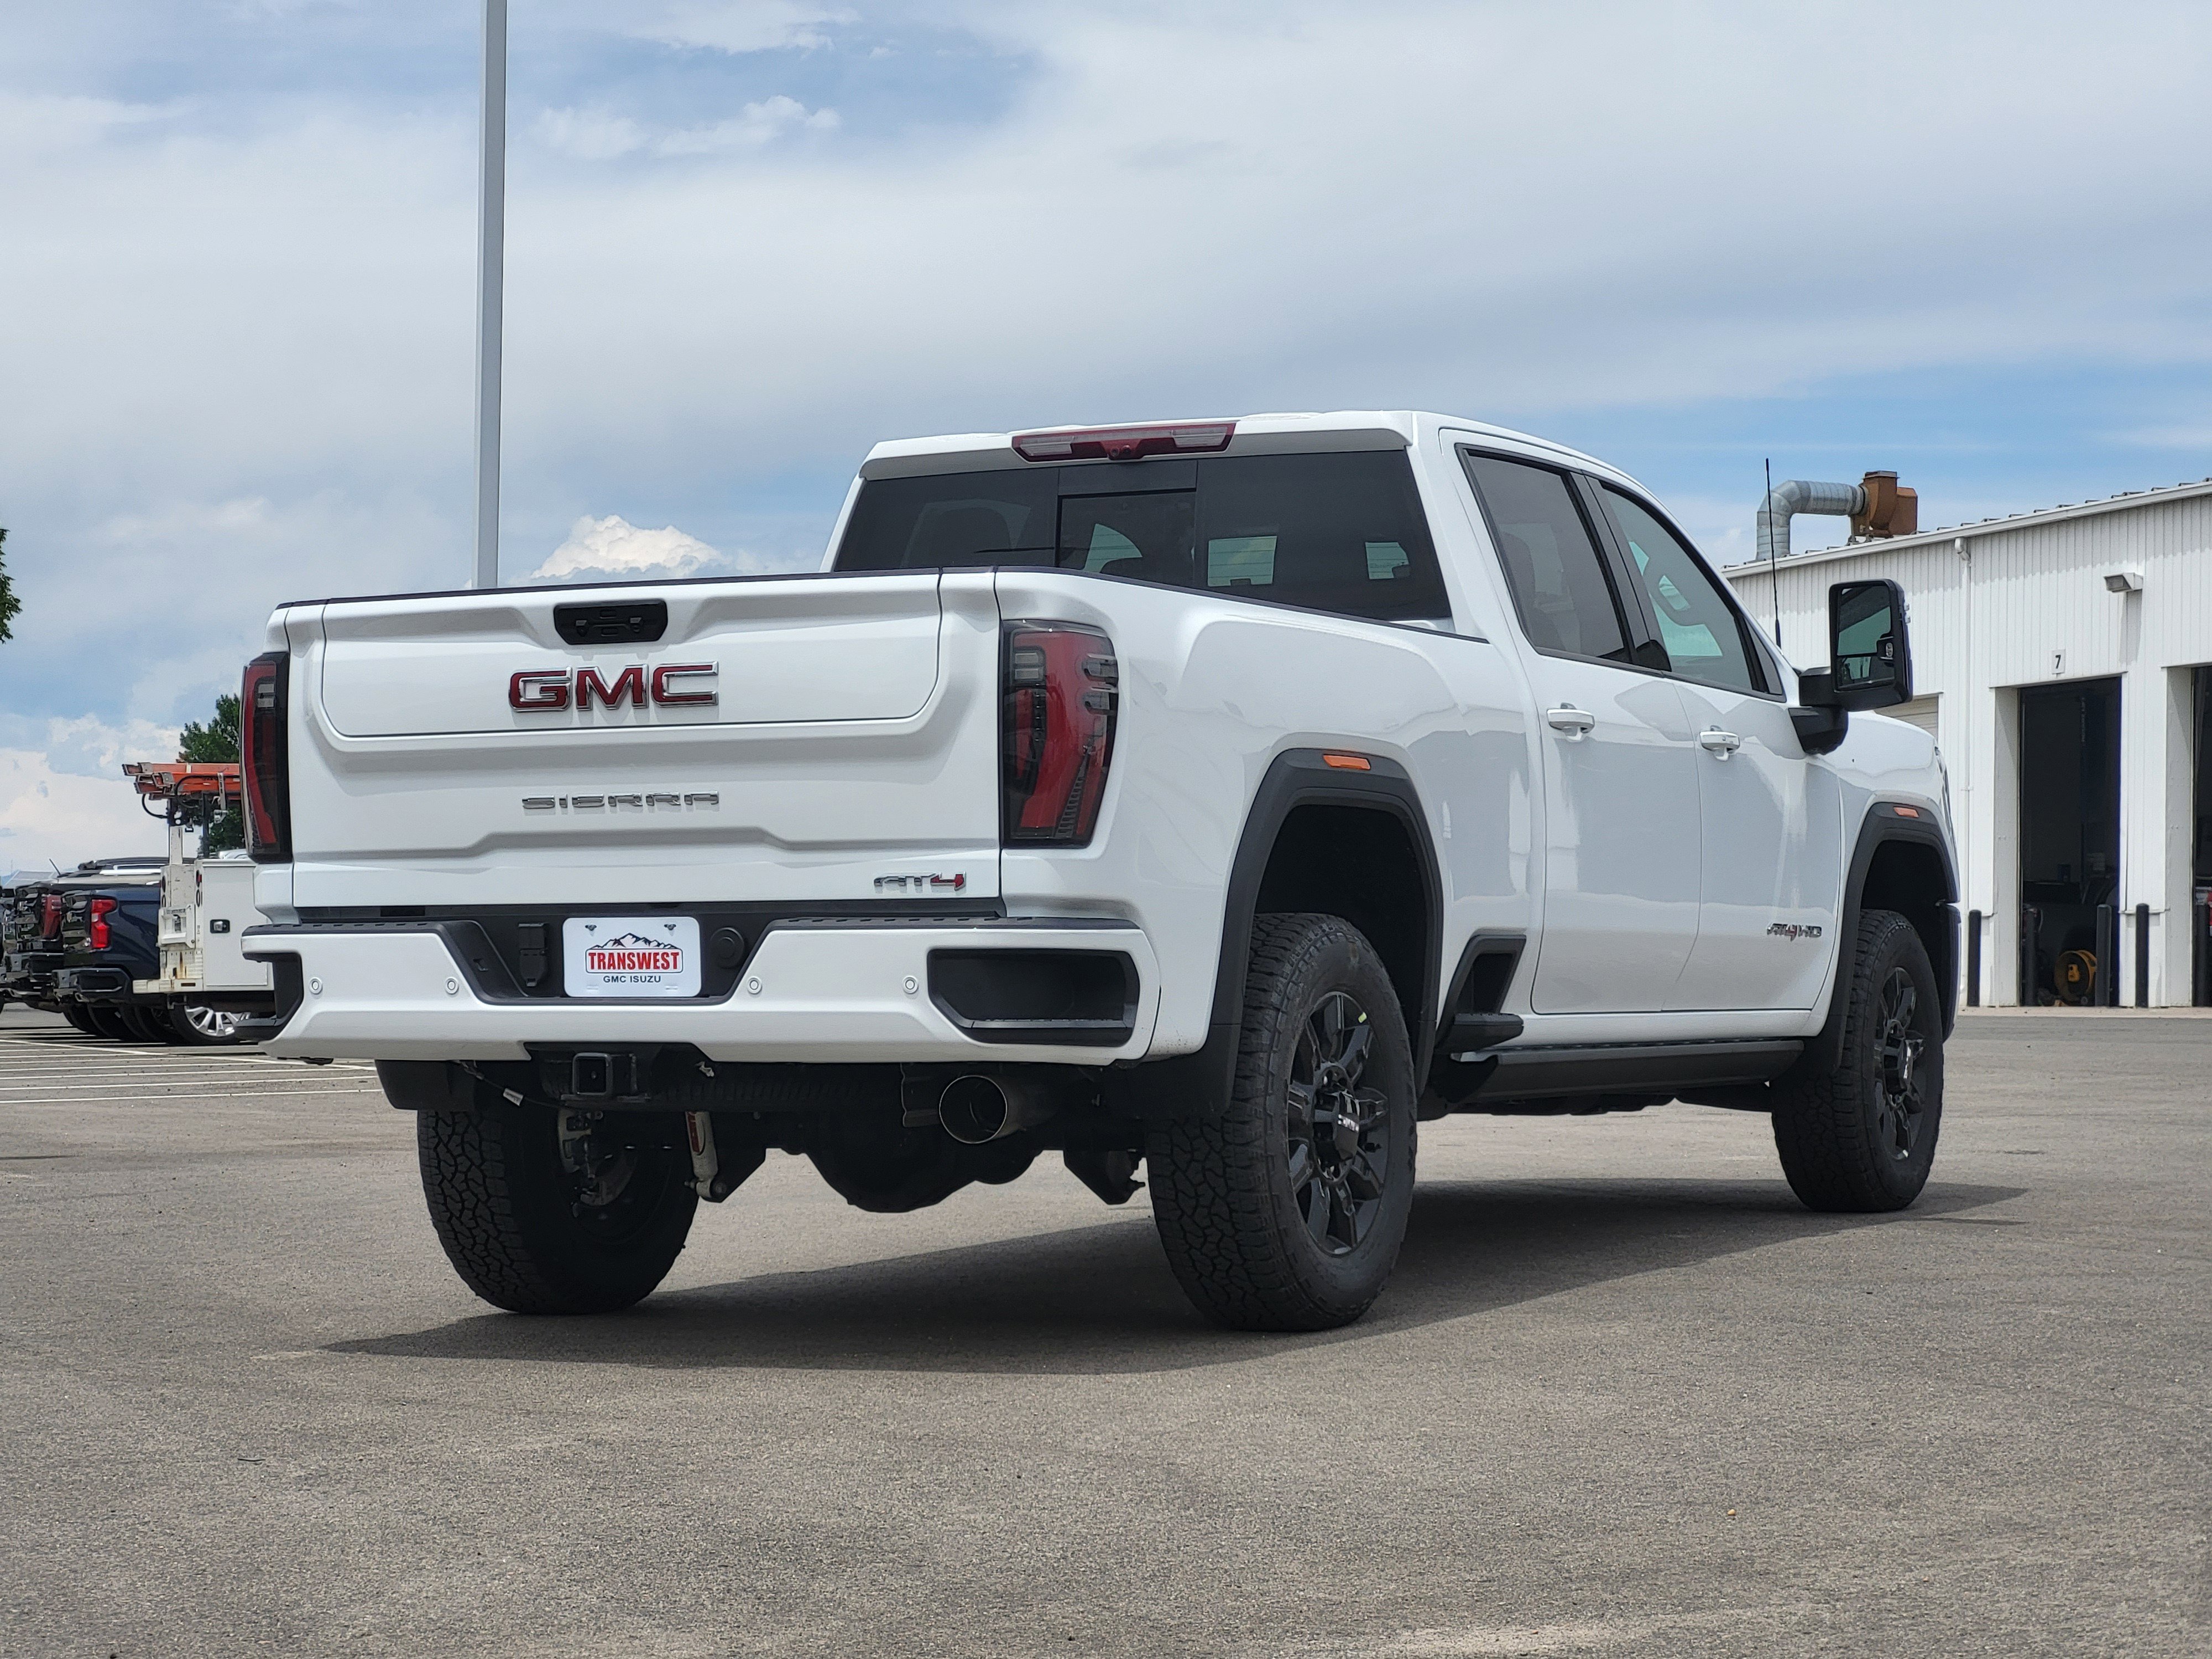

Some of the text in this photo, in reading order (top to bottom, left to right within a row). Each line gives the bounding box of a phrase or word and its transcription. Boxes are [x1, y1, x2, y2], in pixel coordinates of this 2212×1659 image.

[2055, 654, 2061, 669] 7
[508, 661, 719, 713] GMC
[522, 790, 719, 810] SIERRA
[874, 871, 967, 891] AT4
[588, 951, 680, 971] TRANSWEST
[603, 975, 661, 983] GMC ISUZU
